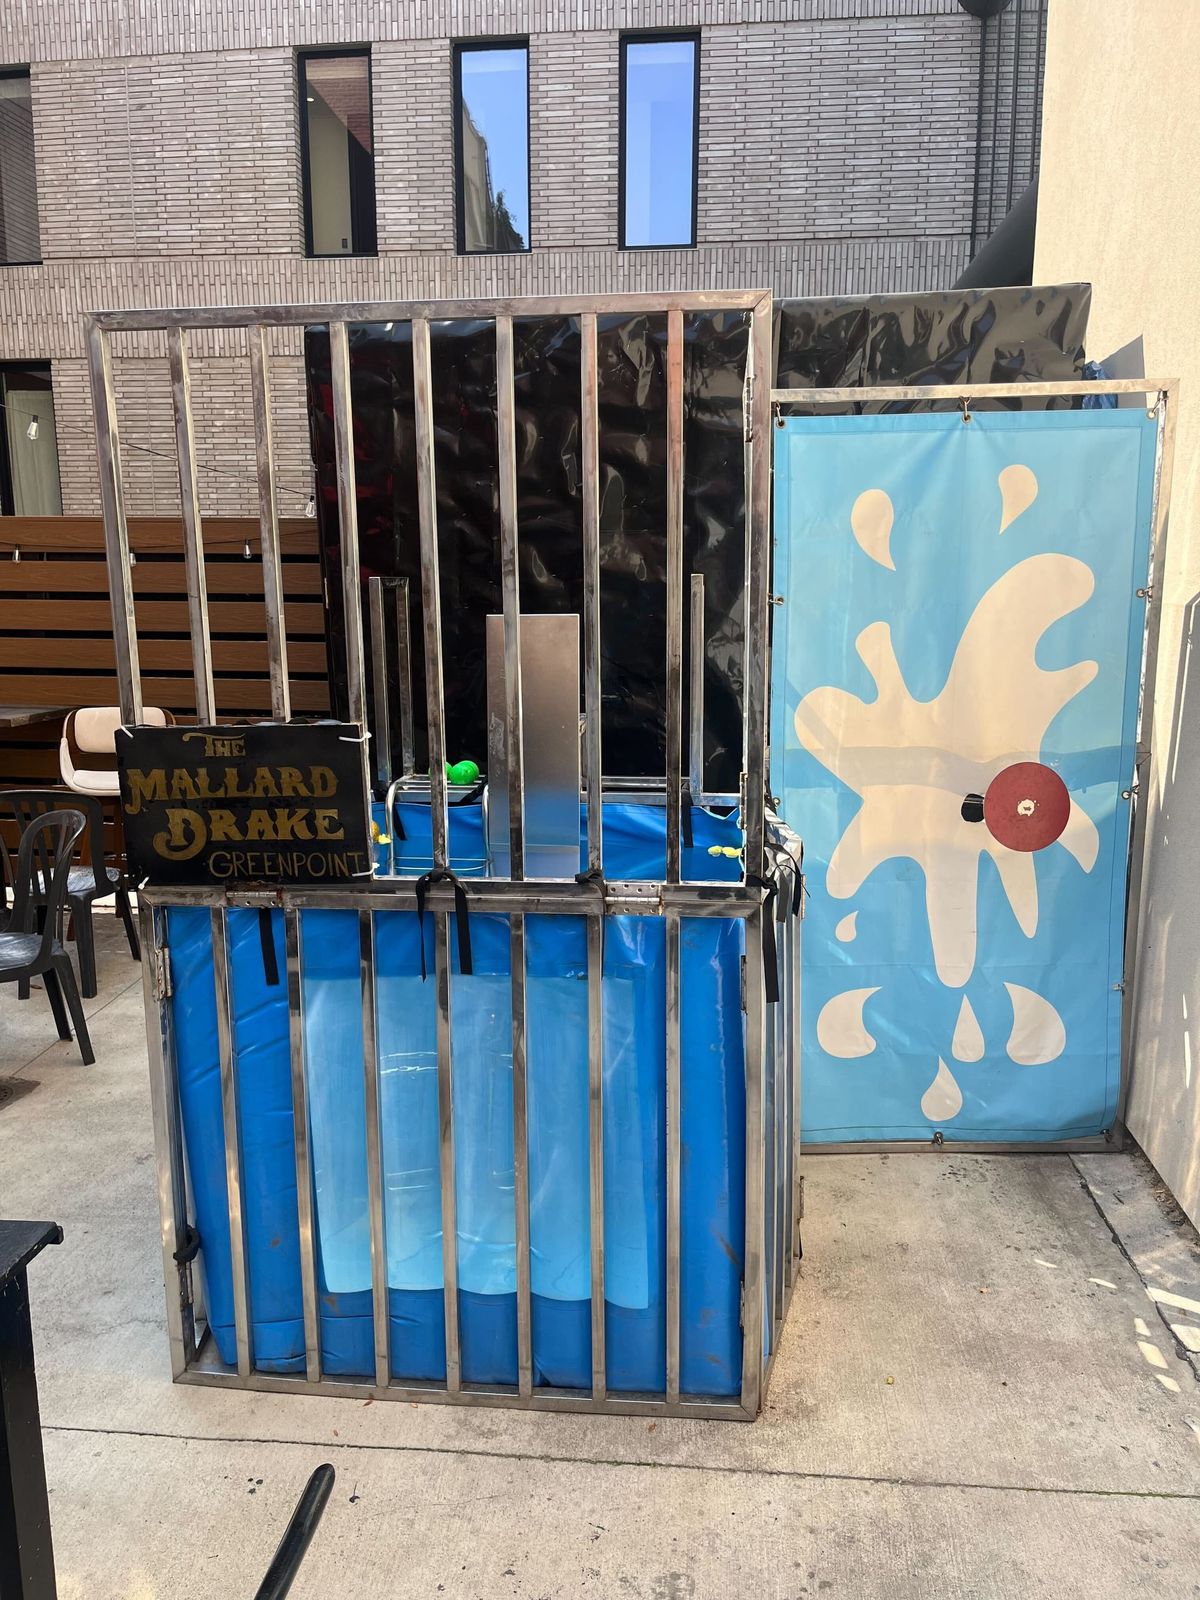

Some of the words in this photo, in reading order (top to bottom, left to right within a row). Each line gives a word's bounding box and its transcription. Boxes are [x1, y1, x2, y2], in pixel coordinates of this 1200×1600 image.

[182, 732, 246, 757] THE
[124, 766, 338, 815] MALLARD
[152, 808, 345, 861] DRAKE
[208, 851, 365, 878] GREENPOINT
